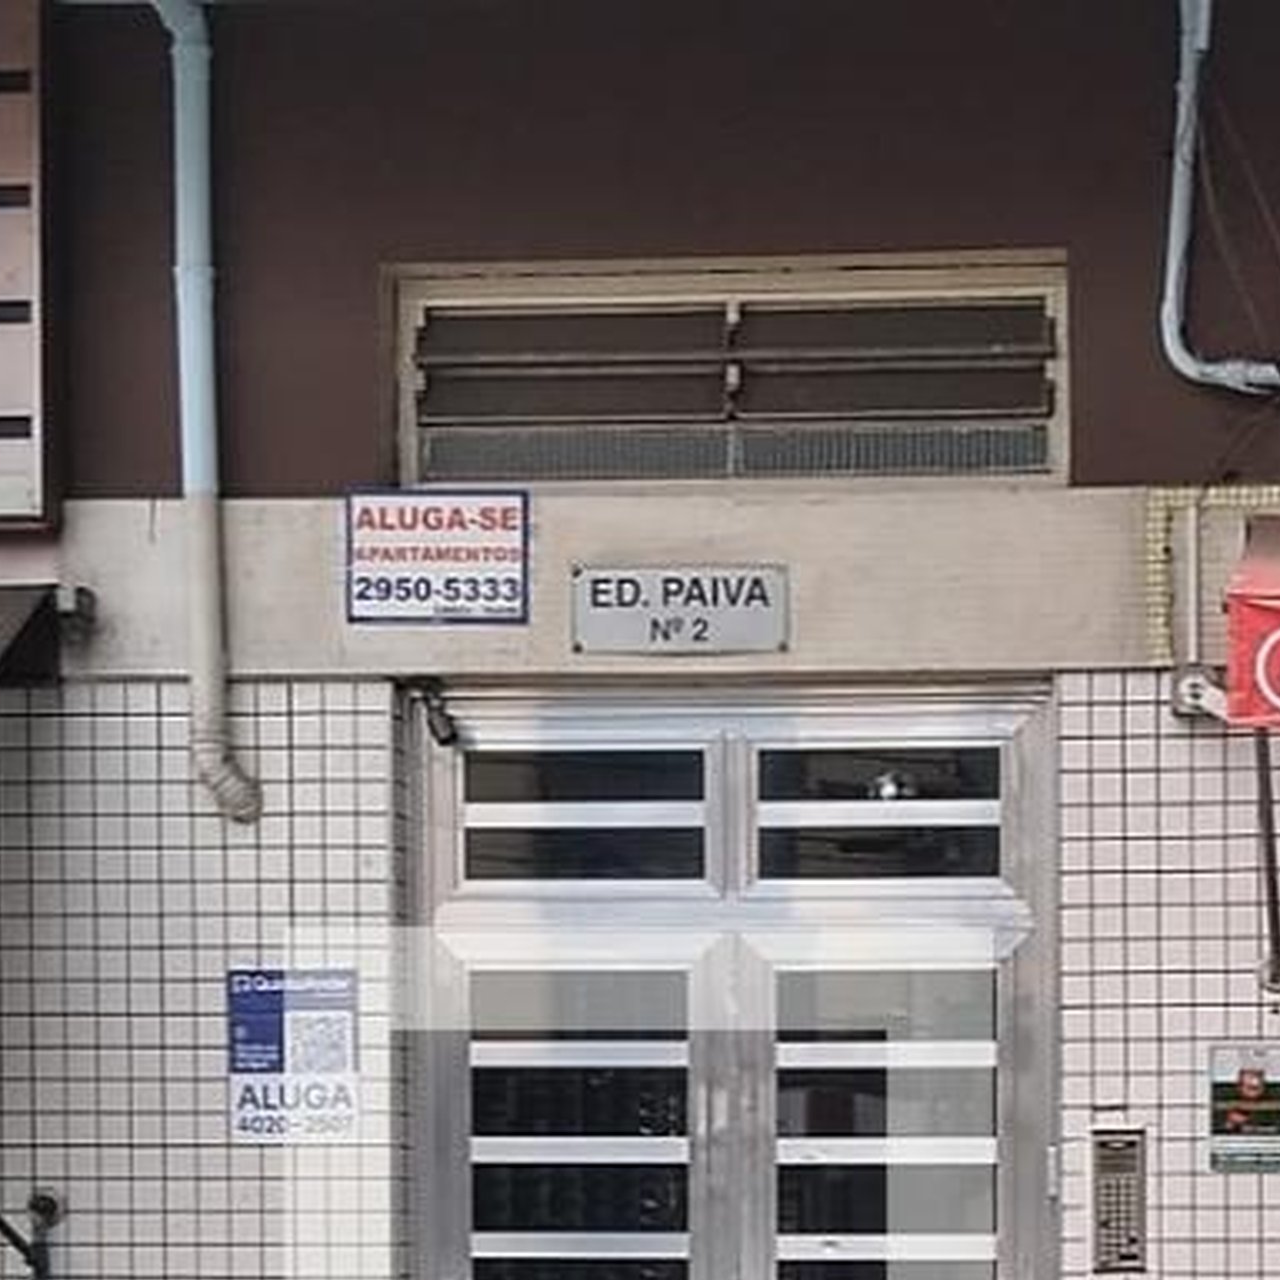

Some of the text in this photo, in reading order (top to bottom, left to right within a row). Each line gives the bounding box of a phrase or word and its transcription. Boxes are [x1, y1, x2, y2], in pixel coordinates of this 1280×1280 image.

[355, 507, 519, 531] ALUGA-SE
[354, 545, 521, 564] APARTAMENTOS
[355, 576, 519, 602] 2950-5333
[590, 576, 771, 608] ED. PAIVA
[692, 616, 709, 642] 2
[236, 1083, 353, 1112] ALUGA
